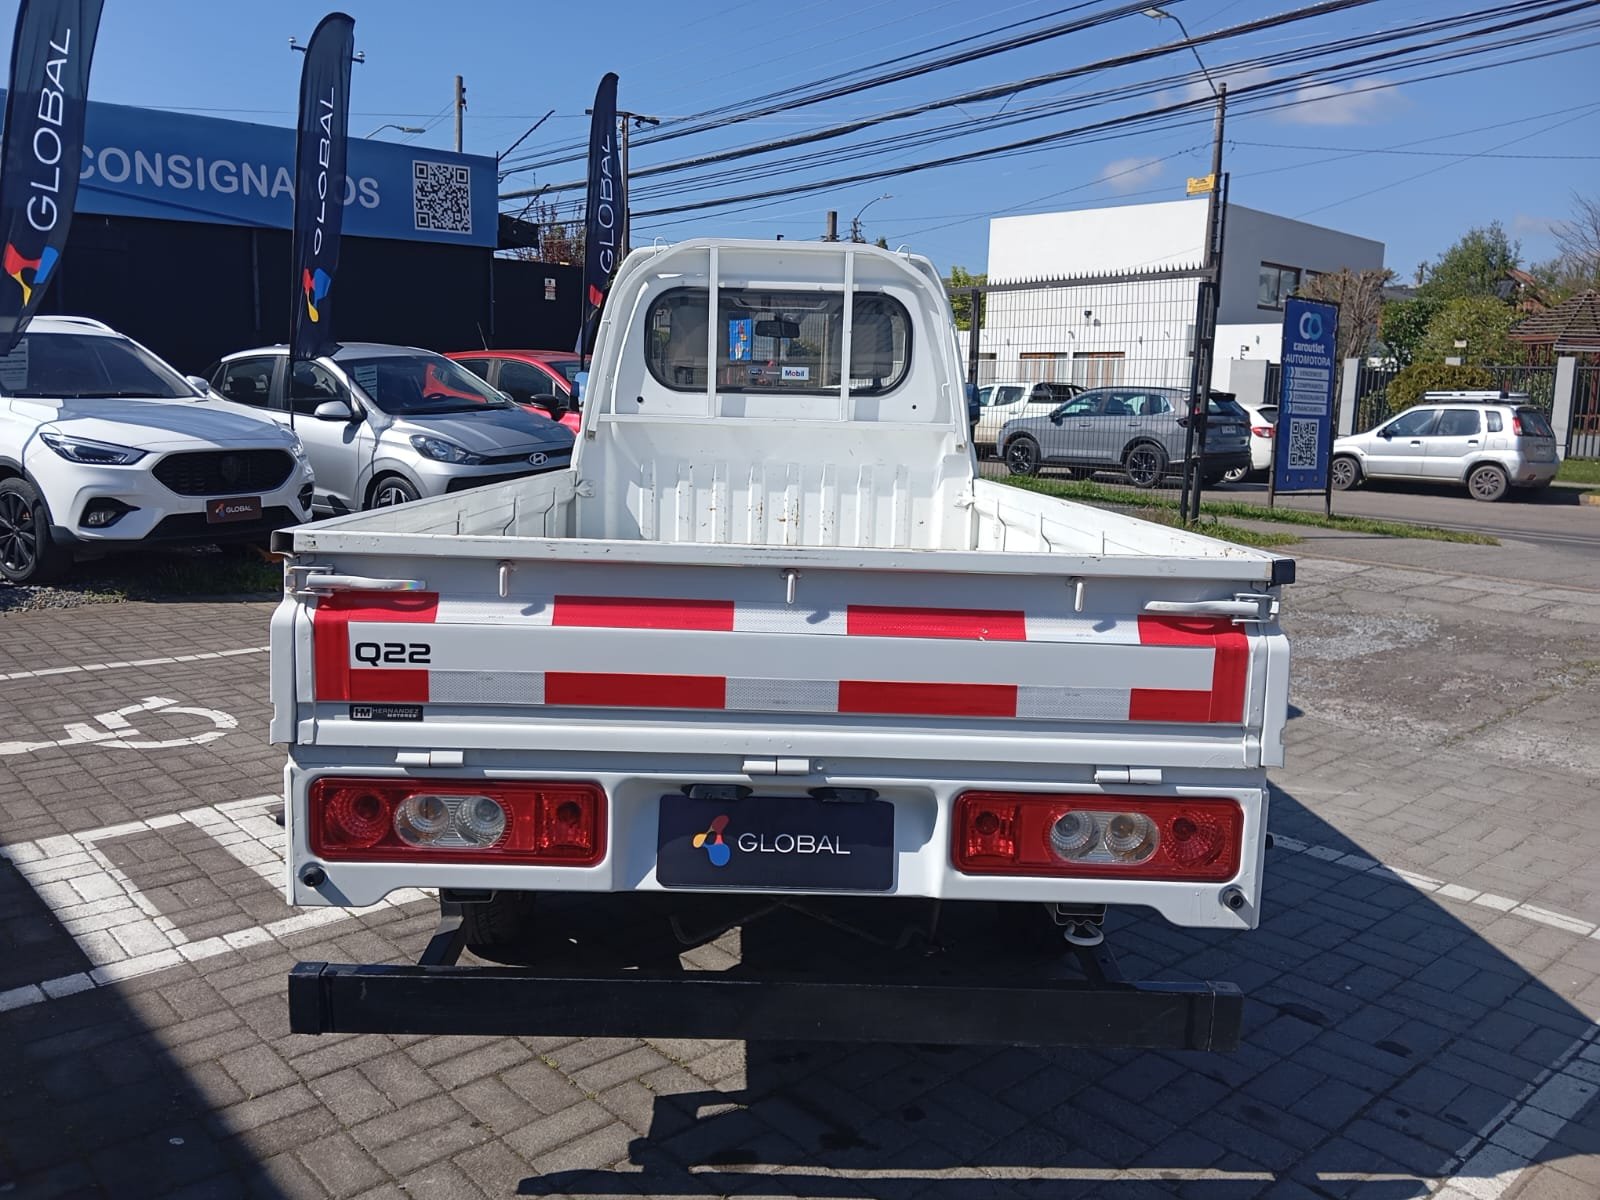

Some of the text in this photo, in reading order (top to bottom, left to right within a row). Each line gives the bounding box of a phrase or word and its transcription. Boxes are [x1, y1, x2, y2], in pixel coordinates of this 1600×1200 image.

[26, 28, 72, 231] GLOBAL
[78, 145, 381, 208] CONSIGNAOS
[598, 134, 615, 274] GLOBAL
[1285, 353, 1331, 367] AUTOMOTORA
[1293, 342, 1325, 354] caroutlet
[355, 642, 431, 667] Q22
[737, 832, 852, 856] GLOBAL
